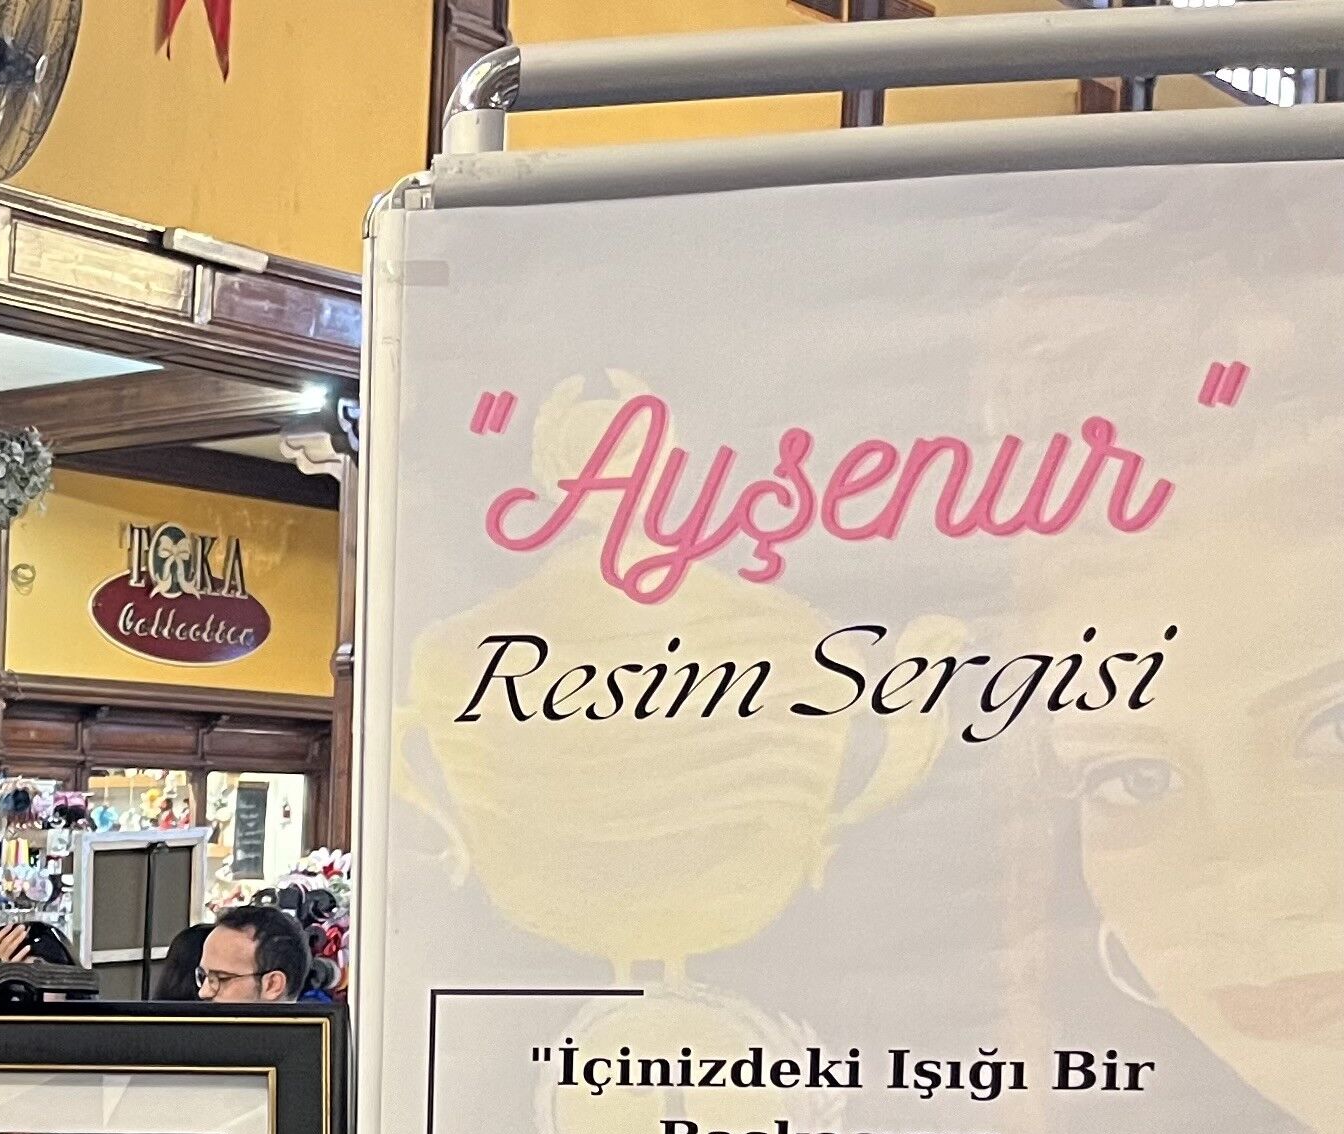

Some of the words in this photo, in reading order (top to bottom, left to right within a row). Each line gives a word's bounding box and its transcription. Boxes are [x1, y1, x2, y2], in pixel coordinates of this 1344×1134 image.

[122, 521, 249, 599] TOKA
[454, 635, 770, 722] Resim
[790, 625, 1178, 743] Sergisi
[532, 1037, 863, 1096] "İçinizdeki
[887, 1047, 1028, 1102] Işığı
[1052, 1049, 1156, 1092] Bir
